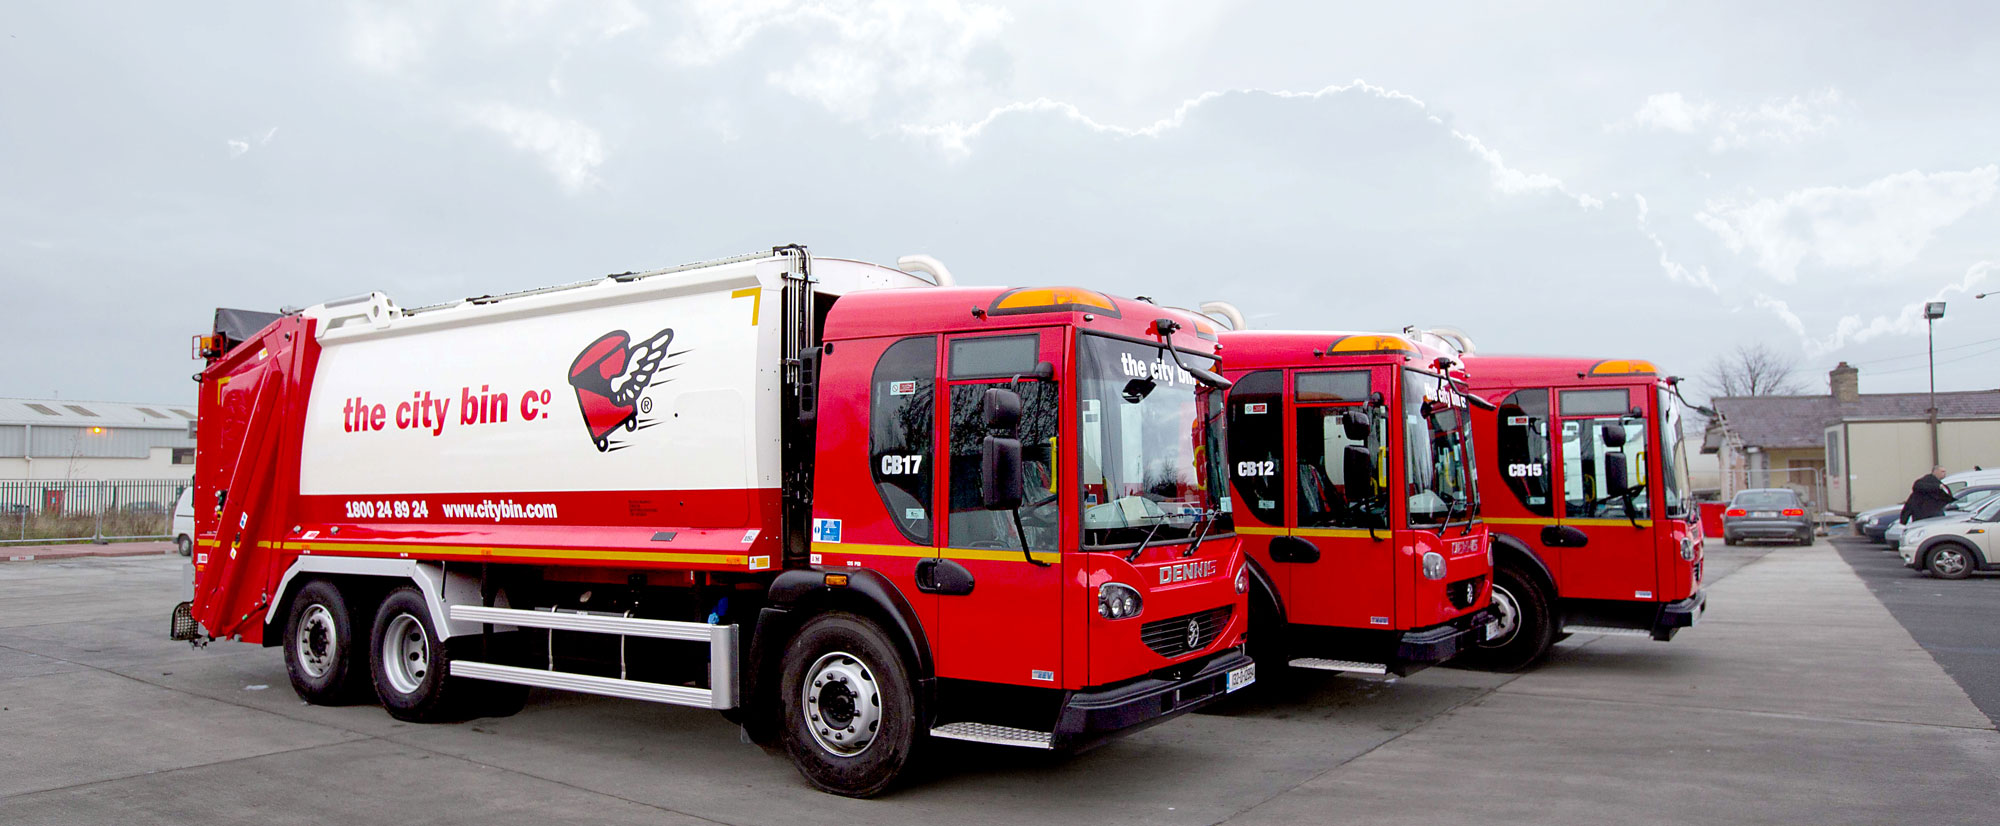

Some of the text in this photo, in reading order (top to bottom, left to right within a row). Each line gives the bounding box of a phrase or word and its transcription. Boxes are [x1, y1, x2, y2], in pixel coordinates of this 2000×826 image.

[1121, 353, 1147, 378] the
[1150, 358, 1174, 387] city
[343, 397, 386, 433] the
[396, 391, 450, 436] city
[460, 384, 508, 425] bin
[881, 454, 923, 475] CB17
[1237, 460, 1275, 477] CB12
[1508, 463, 1543, 477] CB15
[345, 500, 429, 518] 1800 24 89 24
[442, 499, 558, 522] www.citybin.com
[1159, 560, 1217, 585] DENNIS
